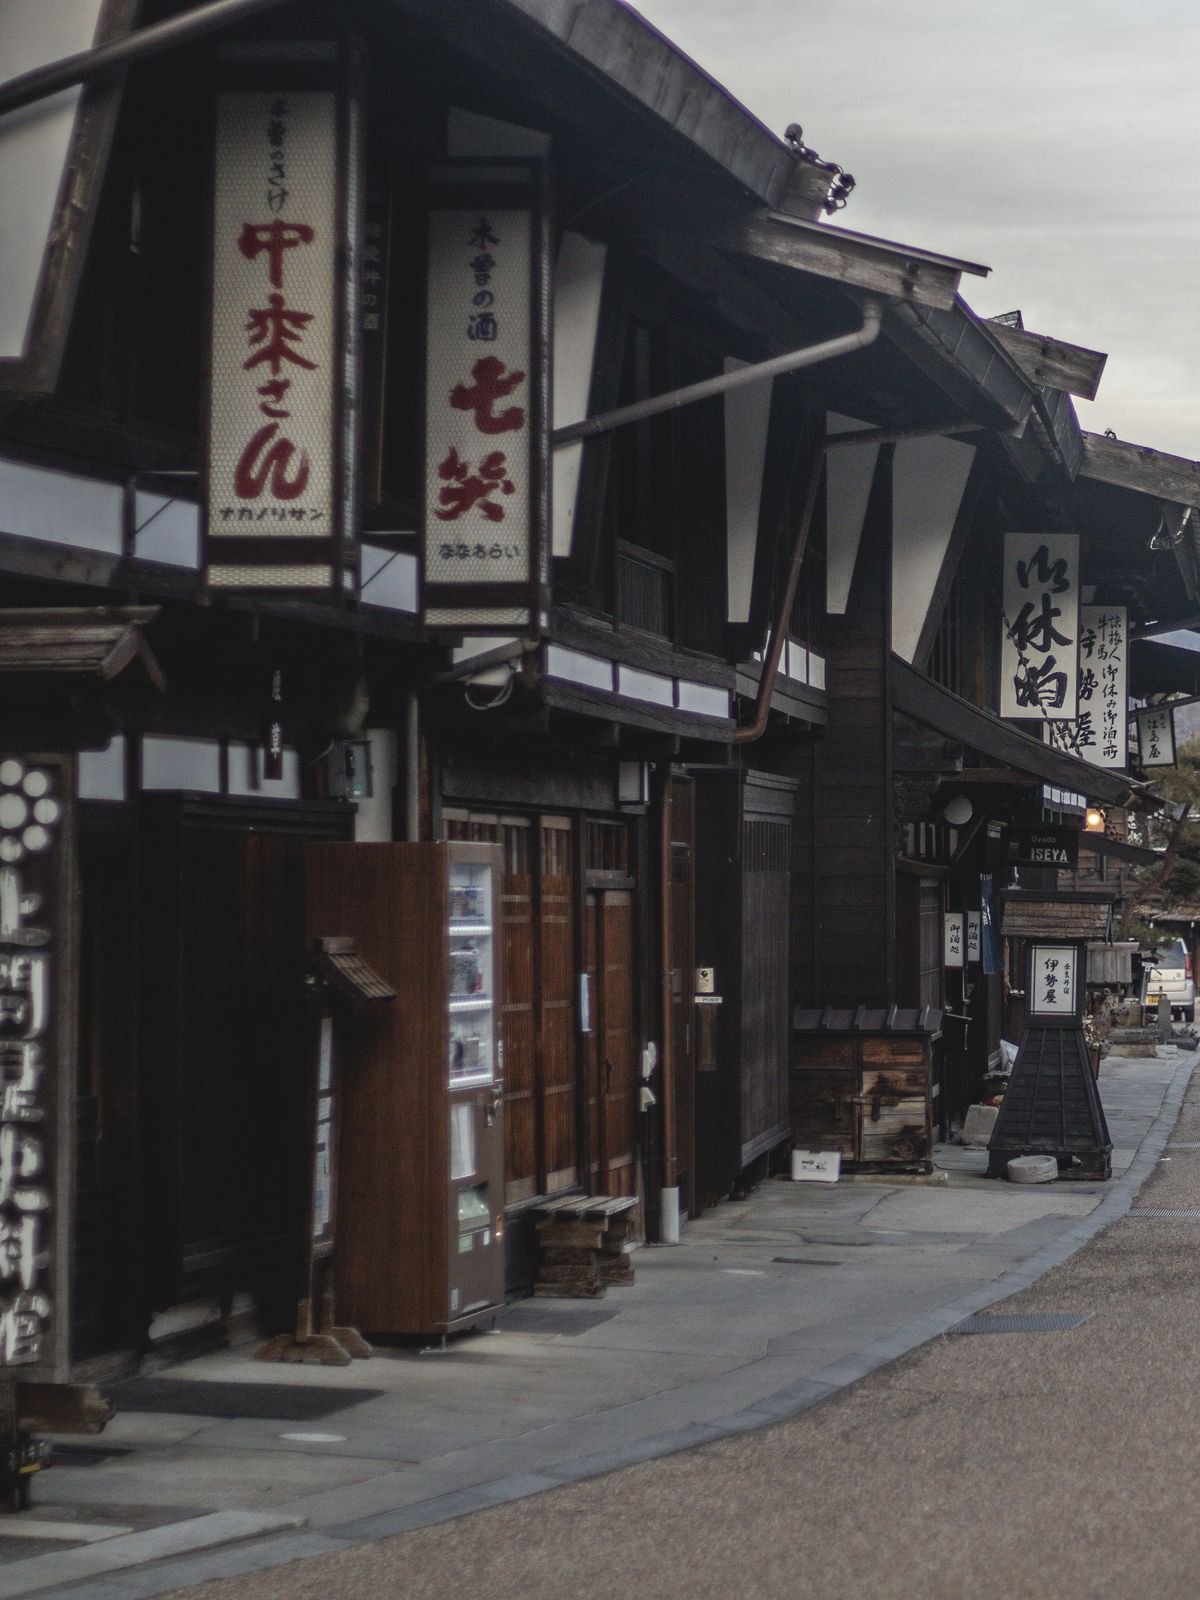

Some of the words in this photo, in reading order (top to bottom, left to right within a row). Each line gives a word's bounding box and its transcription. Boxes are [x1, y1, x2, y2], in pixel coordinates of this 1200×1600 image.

[1030, 847, 1068, 863] ISEYA
[1042, 957, 1059, 1004] 伊勢屋
